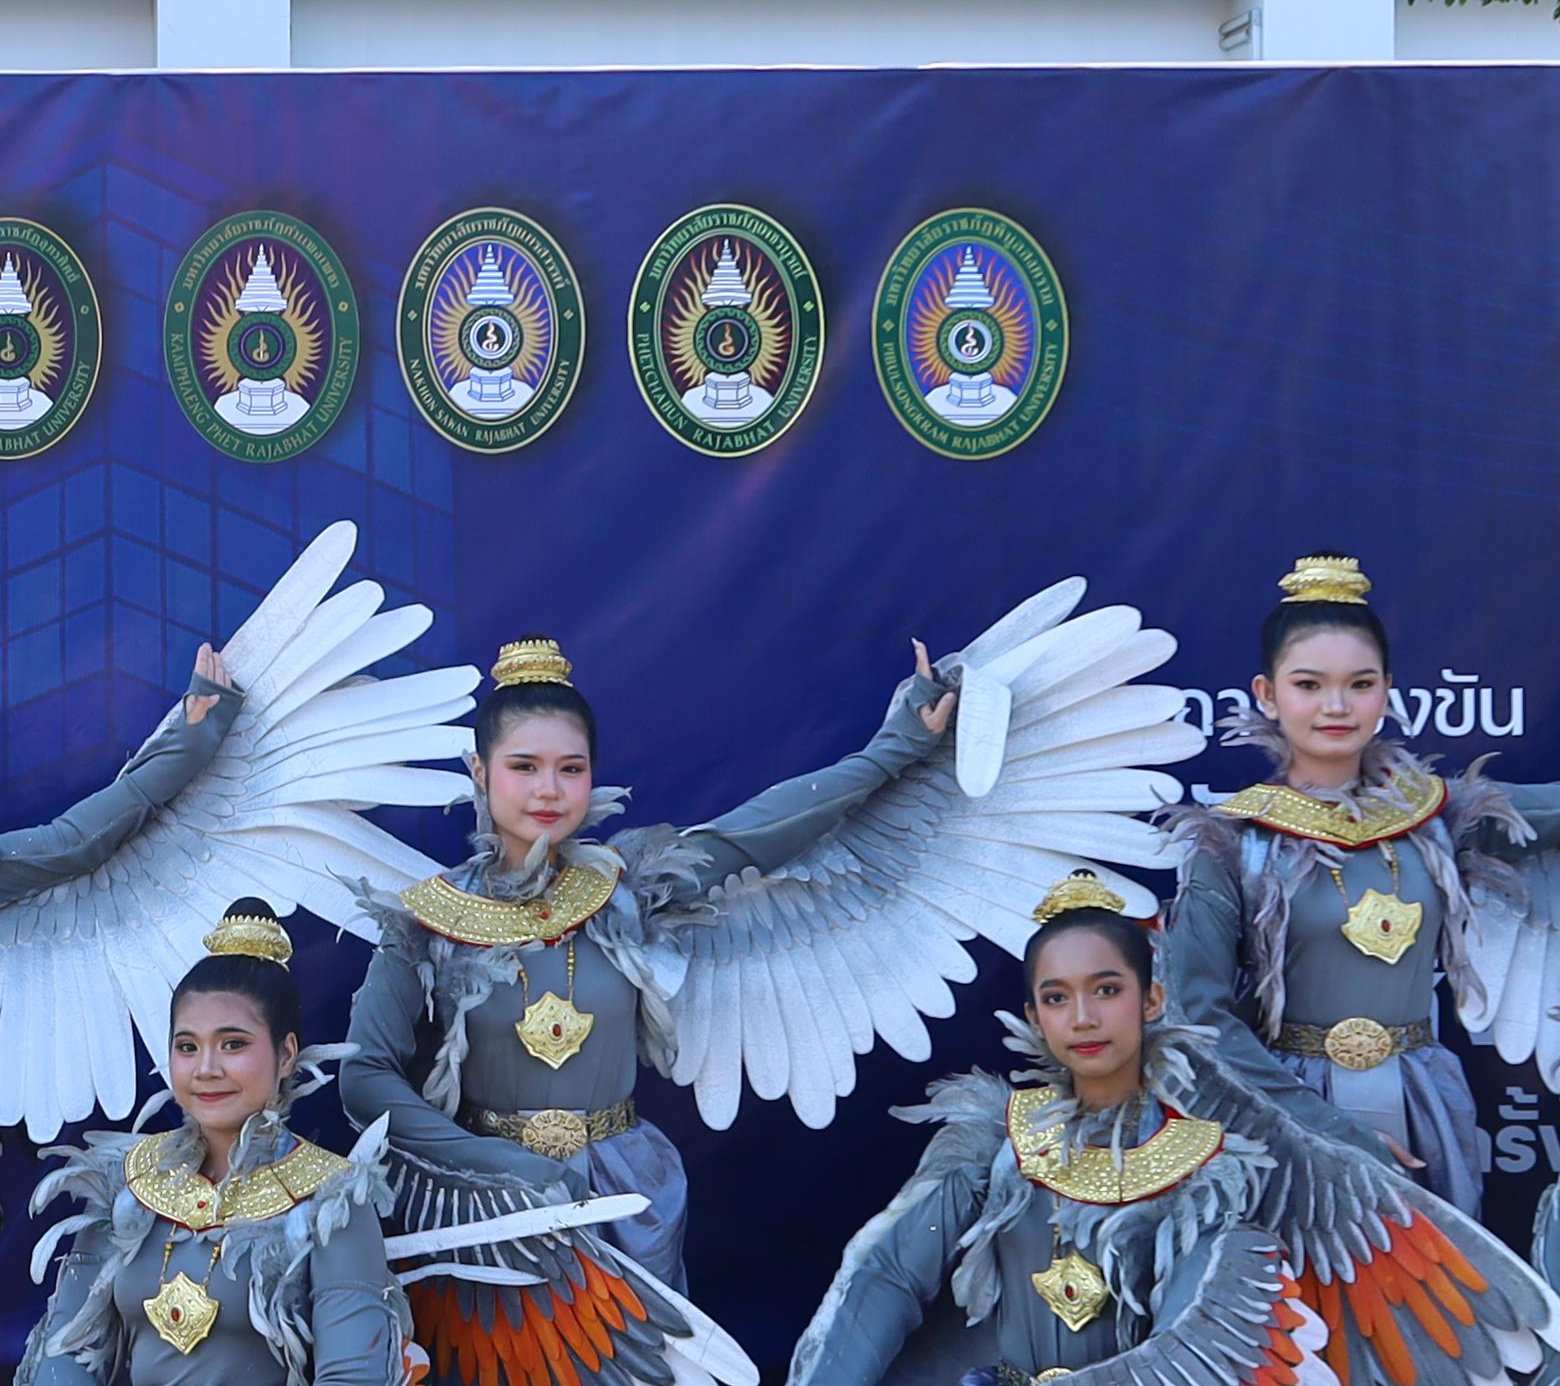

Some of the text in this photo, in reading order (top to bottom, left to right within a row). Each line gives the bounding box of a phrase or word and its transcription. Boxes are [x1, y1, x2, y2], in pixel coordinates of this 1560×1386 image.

[43, 361, 92, 437] UNIVERSITY
[171, 333, 353, 460] KAMPHAENG PHET RAJABHAT UNIVERSITY
[411, 358, 571, 445] NAKHON SAWAN RAJABHAT UNIVERSITY
[637, 333, 817, 450] PHETCHABUN RAJABHAT UNIVERSITY
[883, 342, 1058, 453] PIBULSONGKRAM RAJABHAT UNIVERSITY
